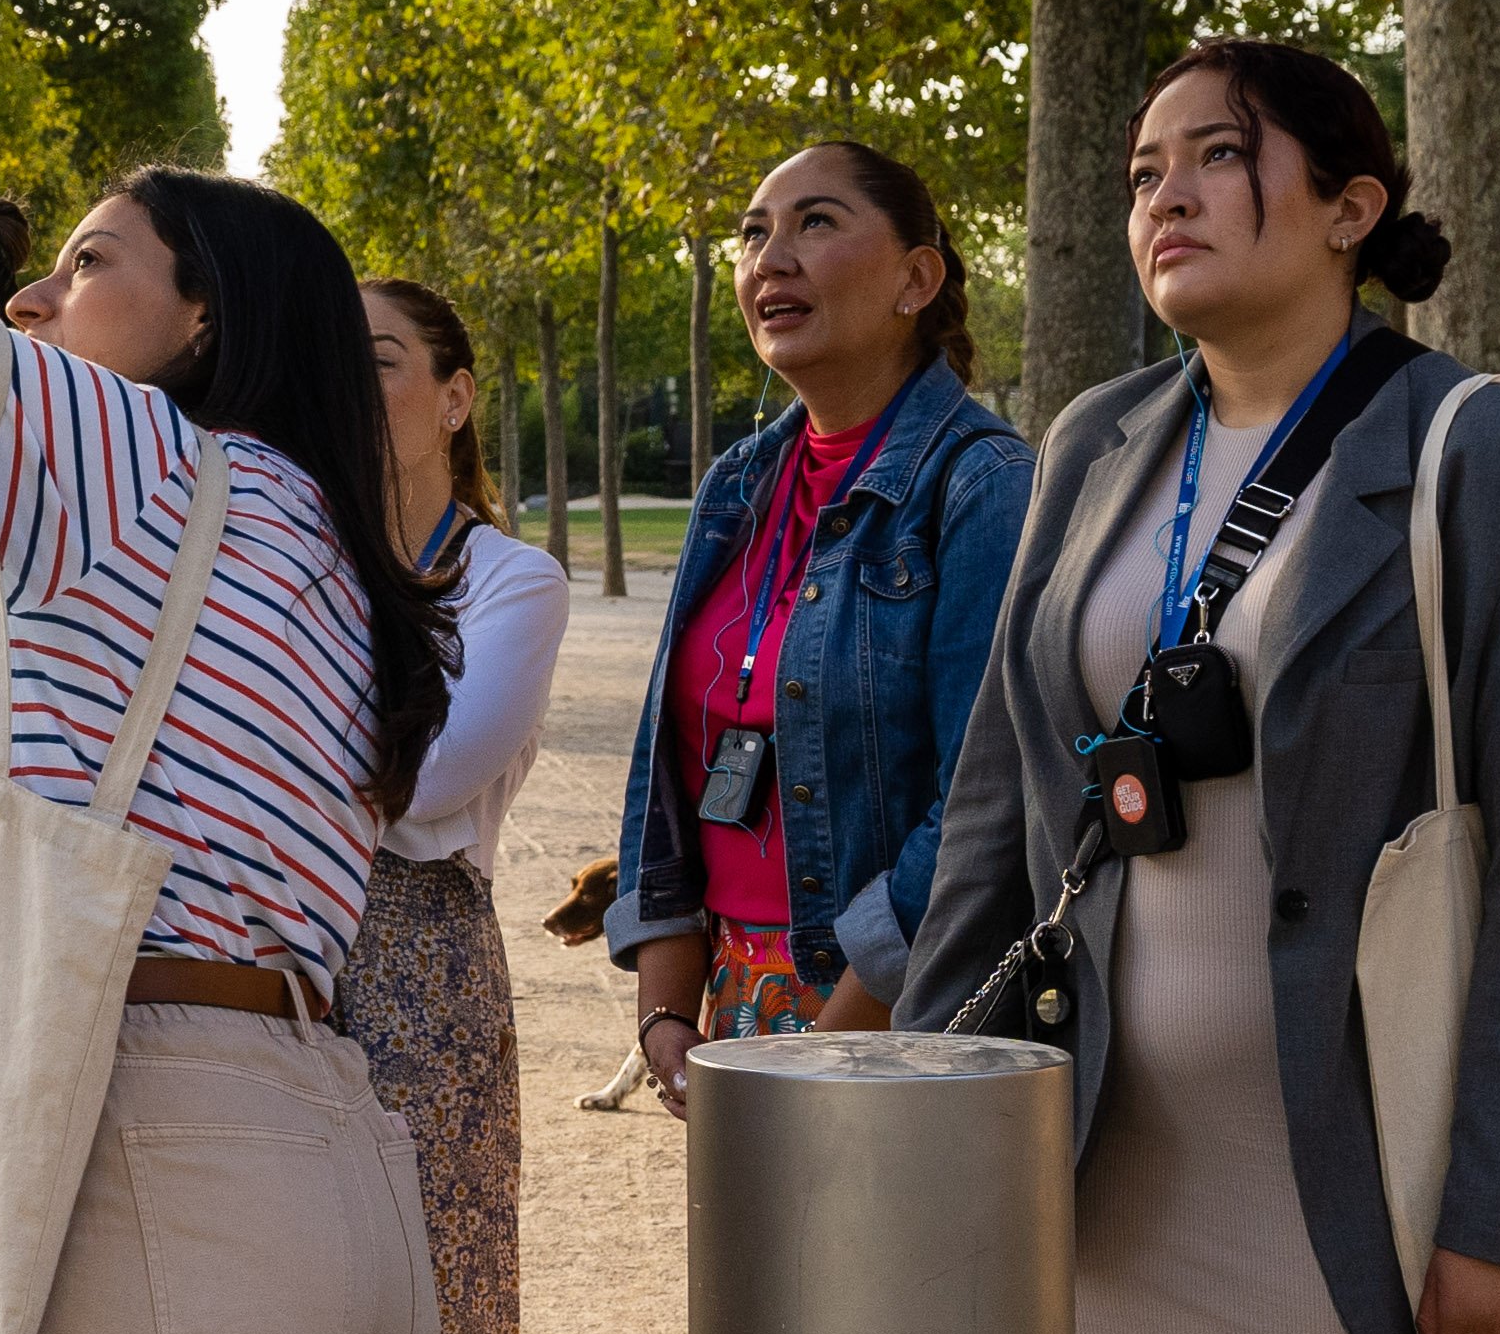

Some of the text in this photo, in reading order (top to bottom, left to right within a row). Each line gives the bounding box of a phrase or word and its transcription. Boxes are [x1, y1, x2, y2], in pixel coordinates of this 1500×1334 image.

[1116, 784, 1131, 795] GET
[1117, 791, 1141, 804] YOUR
[1119, 800, 1145, 815] GUIDE
